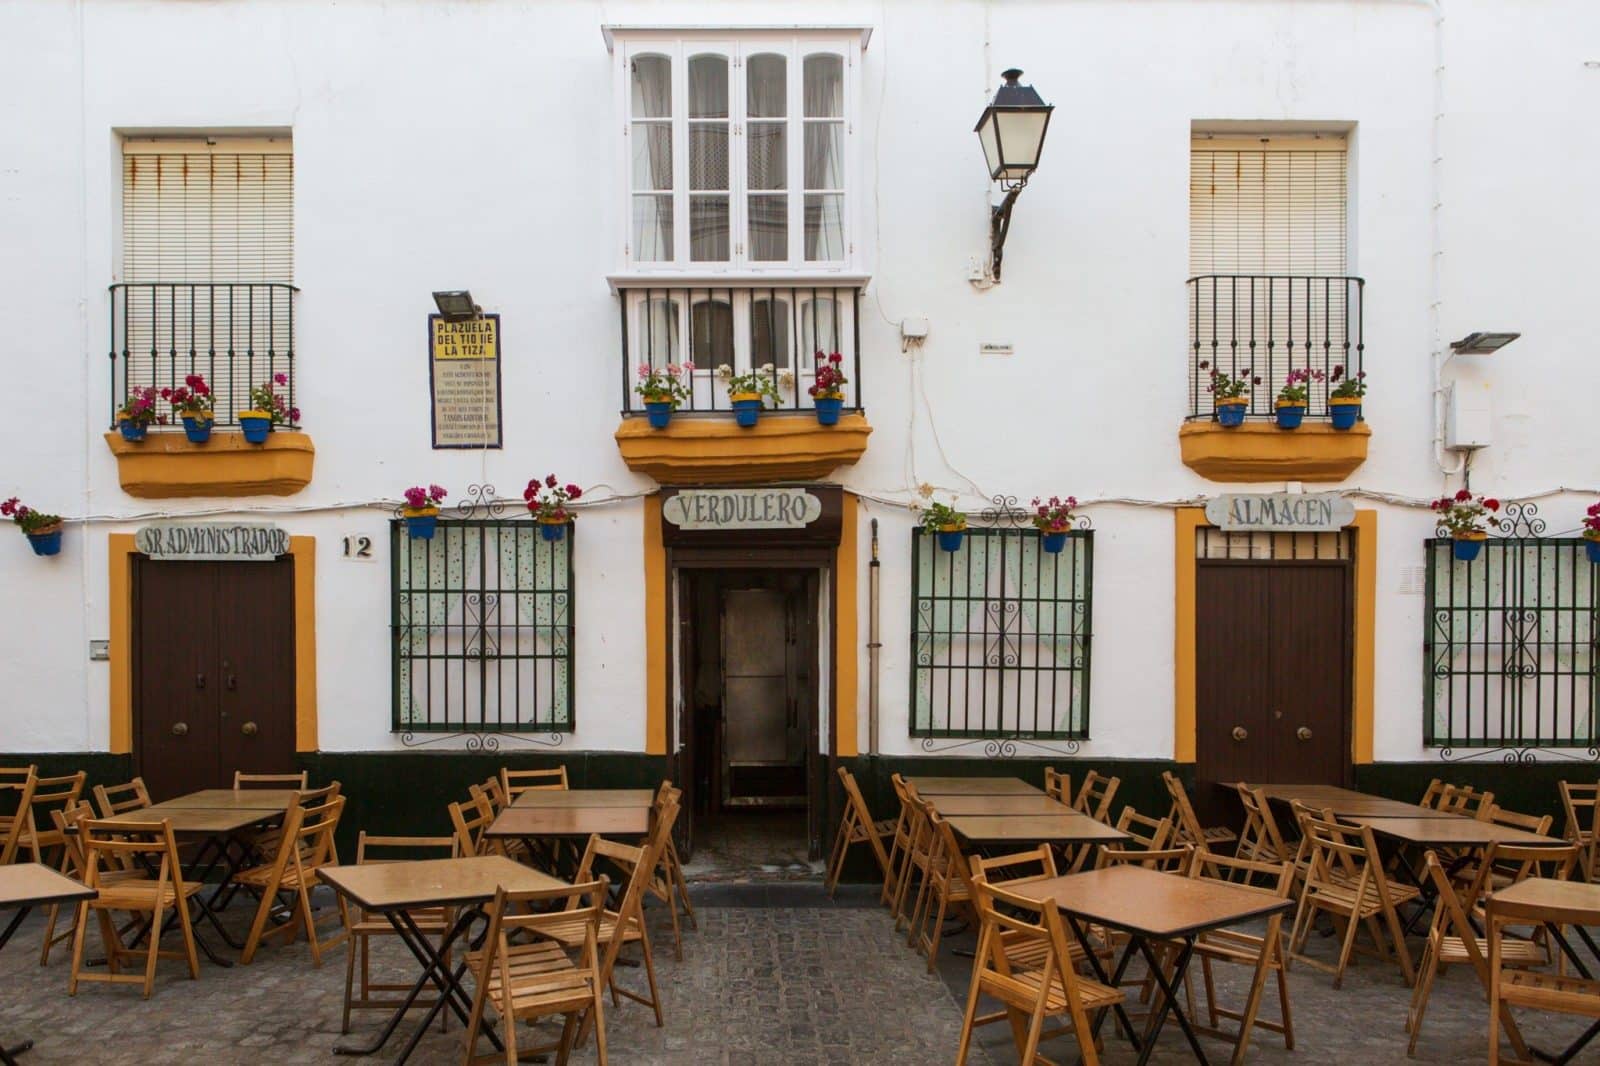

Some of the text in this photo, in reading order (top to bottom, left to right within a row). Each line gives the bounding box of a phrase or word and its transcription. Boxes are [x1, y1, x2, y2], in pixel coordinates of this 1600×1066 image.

[437, 322, 492, 333] PLAZUELA
[437, 333, 493, 345] DEL TIO DE
[445, 345, 458, 356] LA
[676, 493, 808, 526] VERDULERO
[1227, 497, 1333, 526] ALMACEN
[342, 536, 372, 558] 12
